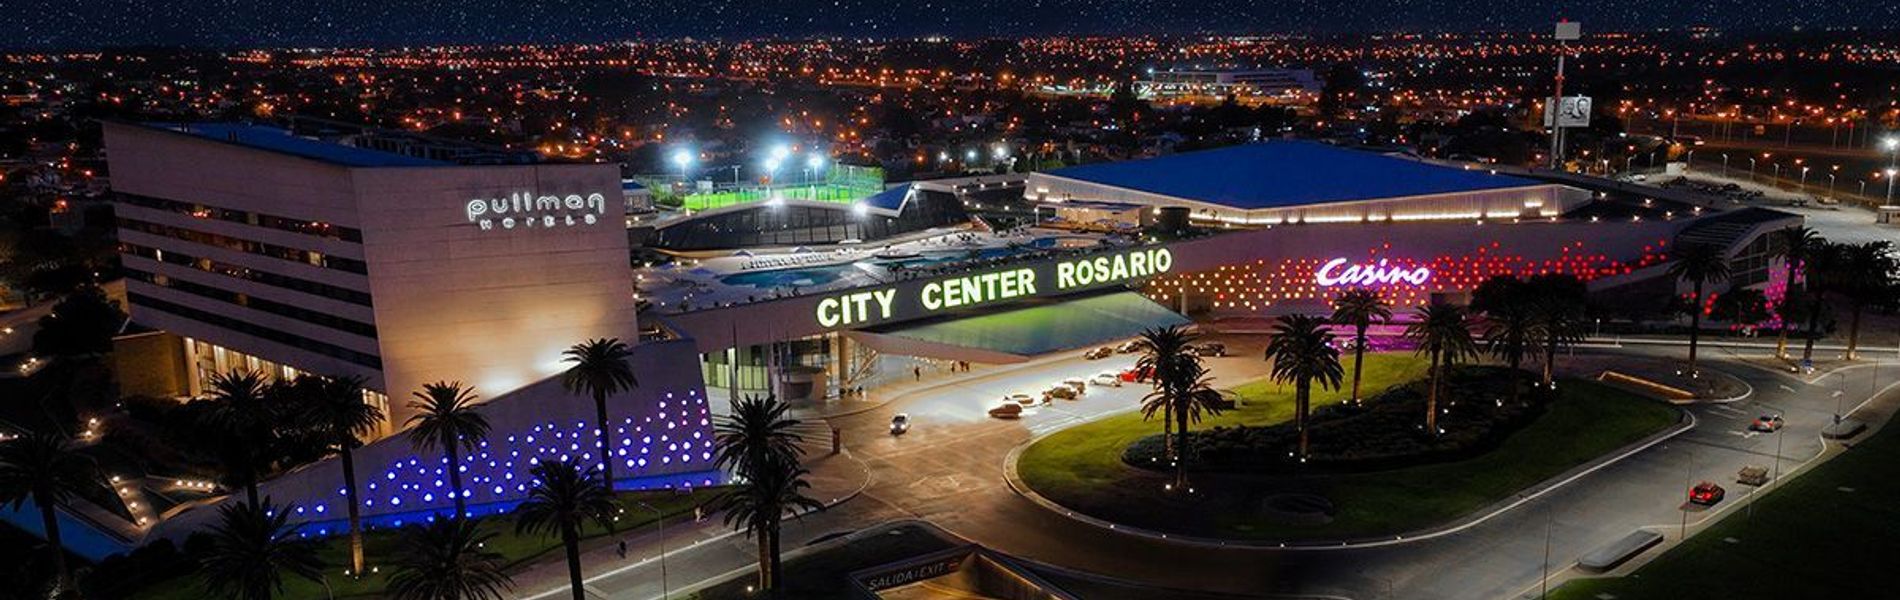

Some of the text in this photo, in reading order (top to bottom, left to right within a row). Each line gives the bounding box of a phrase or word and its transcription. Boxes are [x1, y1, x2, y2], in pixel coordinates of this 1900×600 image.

[467, 191, 605, 222] pullman
[1317, 257, 1430, 286] Casino
[816, 248, 1172, 328] CITY CENTER ROSARIO
[869, 562, 945, 590] SALIDA EXIT
